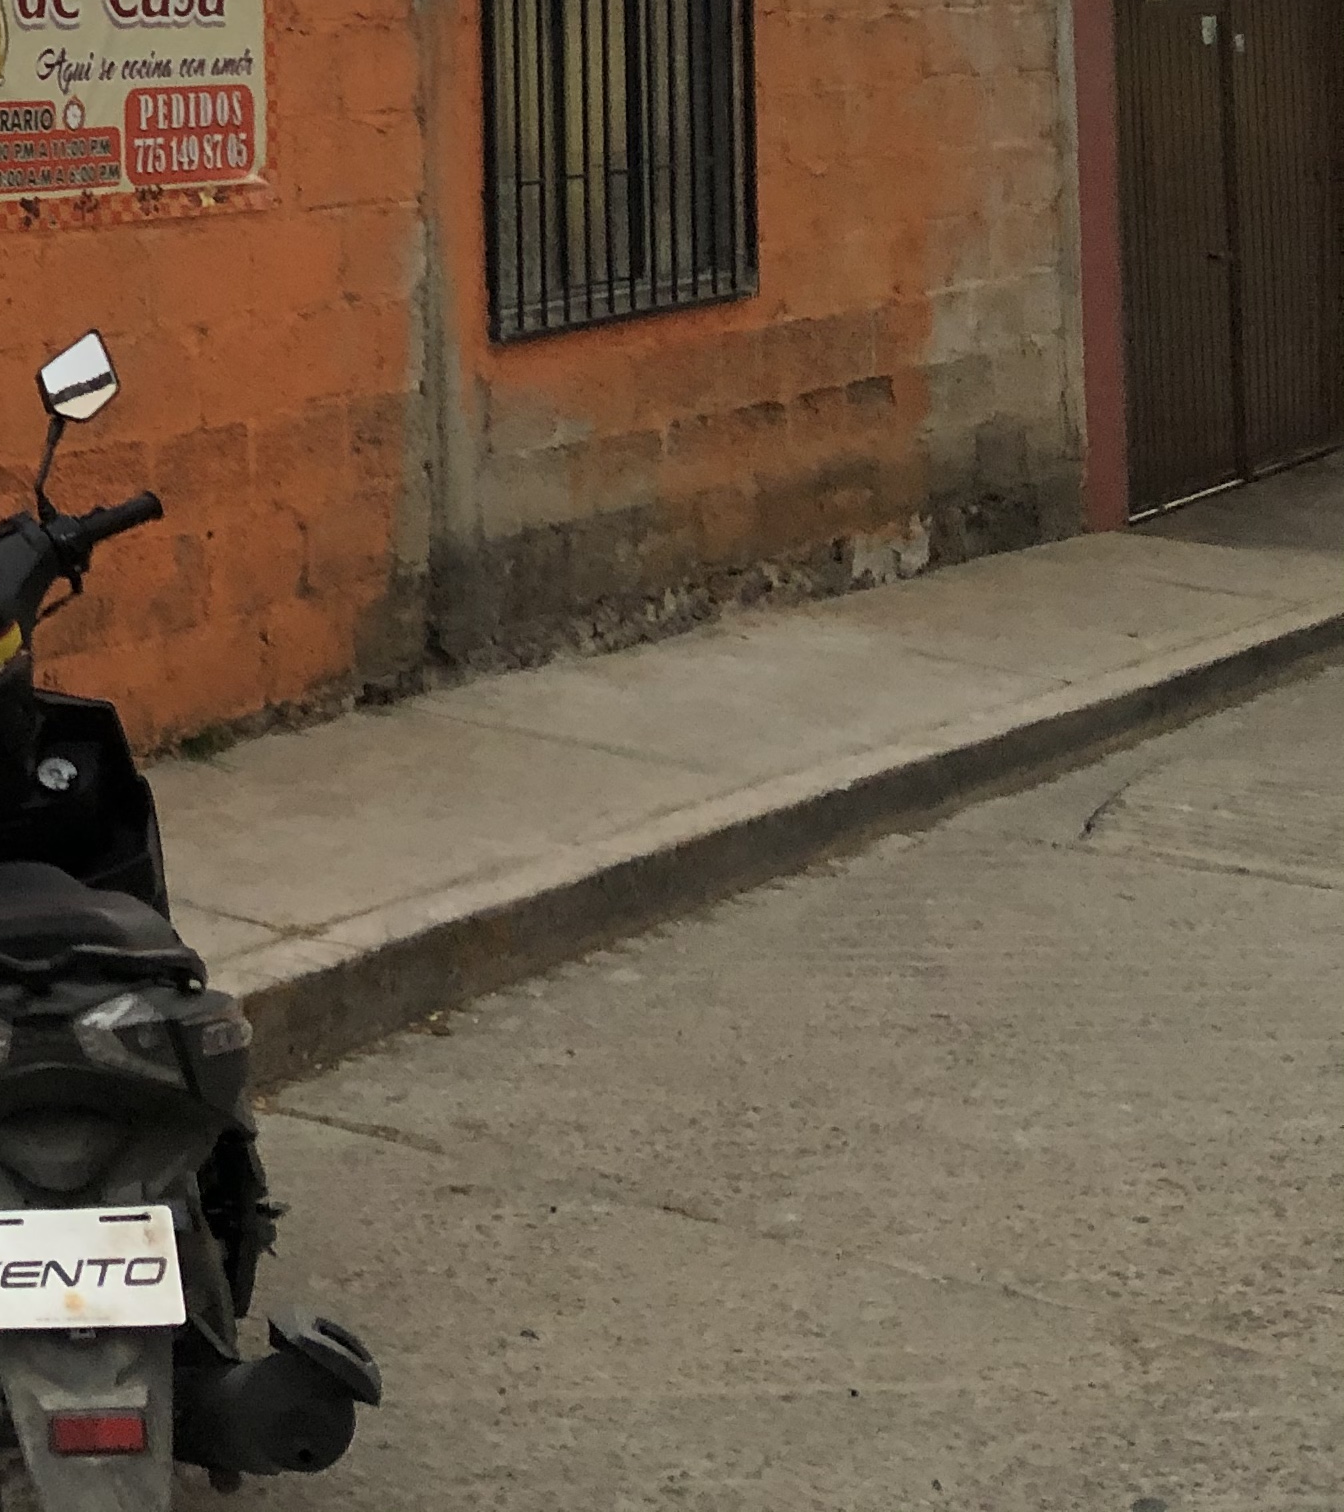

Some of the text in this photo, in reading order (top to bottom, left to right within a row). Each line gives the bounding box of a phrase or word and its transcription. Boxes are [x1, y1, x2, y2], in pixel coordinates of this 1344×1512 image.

[98, 56, 119, 82] se
[121, 49, 173, 81] cocina
[179, 55, 207, 78] con
[212, 47, 255, 77] amor
[137, 90, 244, 132] PEDIDOS
[133, 136, 166, 174] 775
[169, 133, 200, 172] 149
